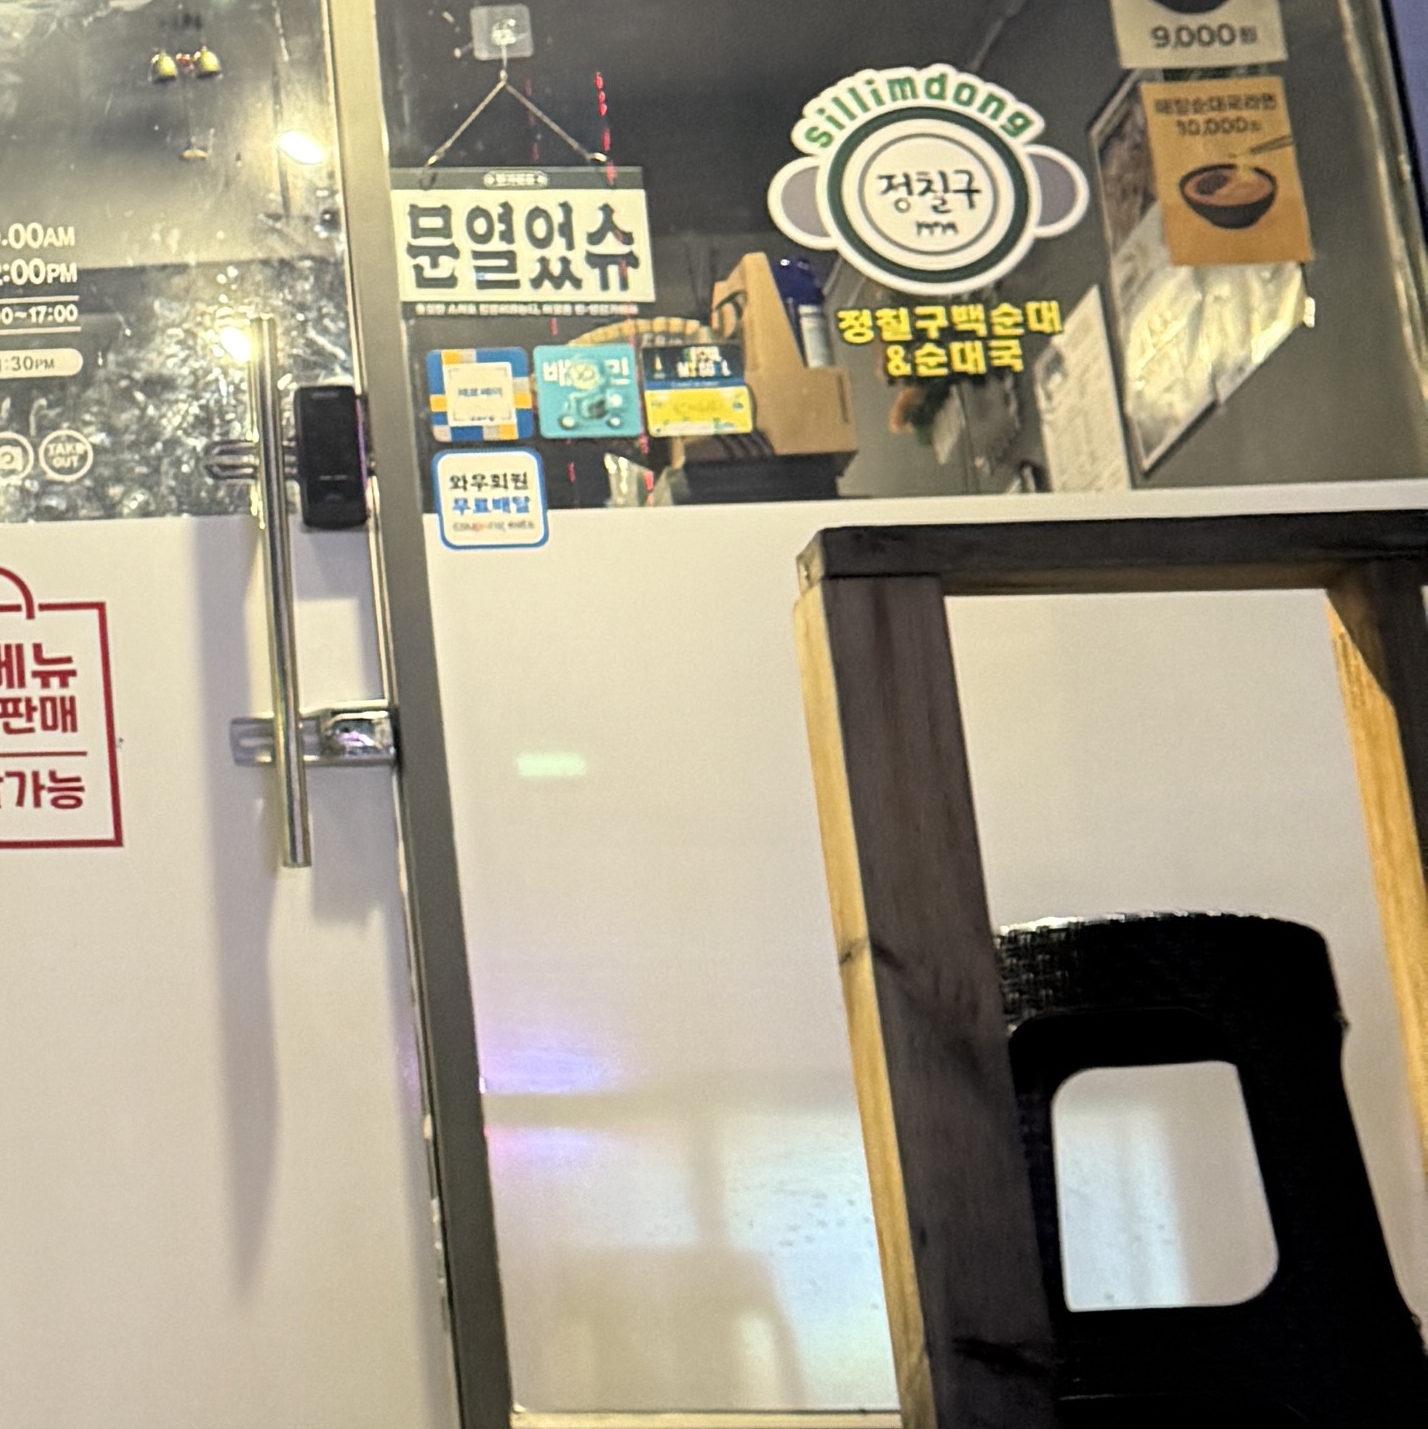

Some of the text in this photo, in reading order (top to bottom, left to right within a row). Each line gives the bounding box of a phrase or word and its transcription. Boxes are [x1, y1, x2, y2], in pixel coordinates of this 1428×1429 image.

[803, 72, 1035, 149] sillimdong
[876, 169, 983, 214] 정칠구
[405, 199, 641, 292] 문열었슈
[836, 300, 1063, 345] 정칠구백순대
[886, 338, 1024, 377] &순대국
[449, 471, 529, 492] 와우회원
